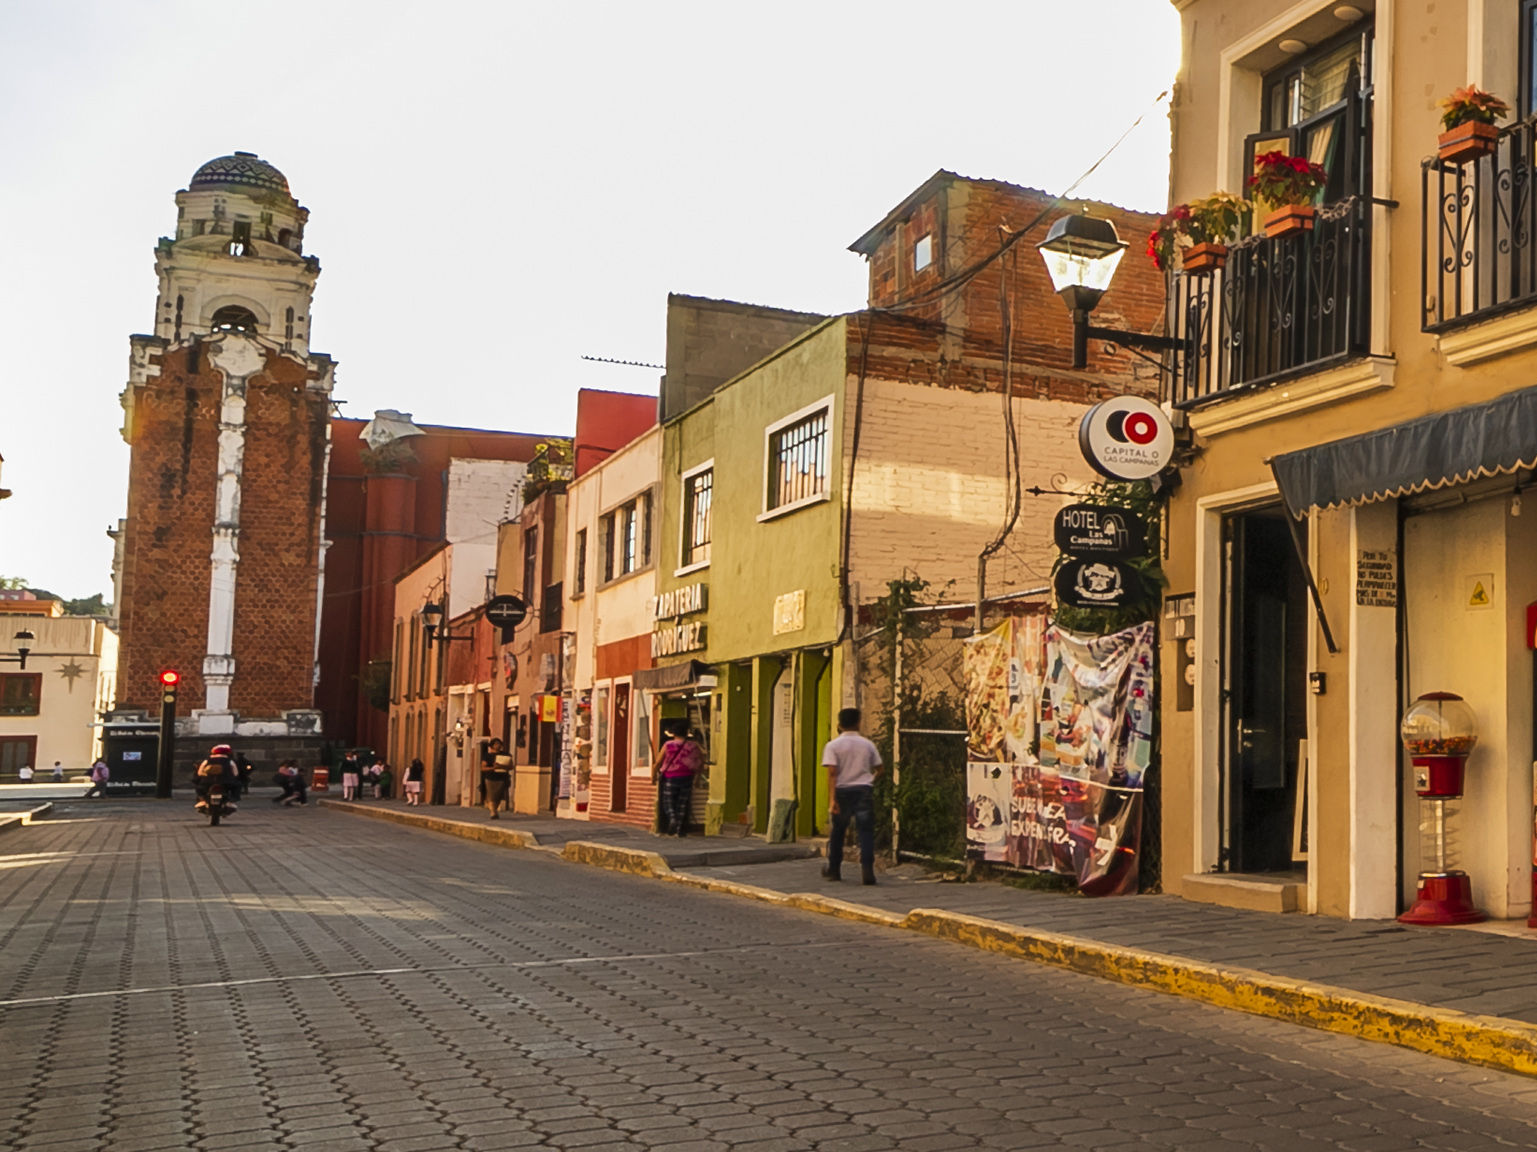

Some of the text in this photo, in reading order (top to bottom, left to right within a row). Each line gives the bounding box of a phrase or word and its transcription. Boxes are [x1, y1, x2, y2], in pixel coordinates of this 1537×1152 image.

[1104, 446, 1159, 459] CAPITAL O
[1103, 455, 1160, 467] LAS CAMPANAS
[1062, 510, 1101, 529] HOTEL
[1089, 530, 1104, 538] Las
[1070, 535, 1113, 546] Campanas
[653, 582, 702, 620] ZAPATERIA
